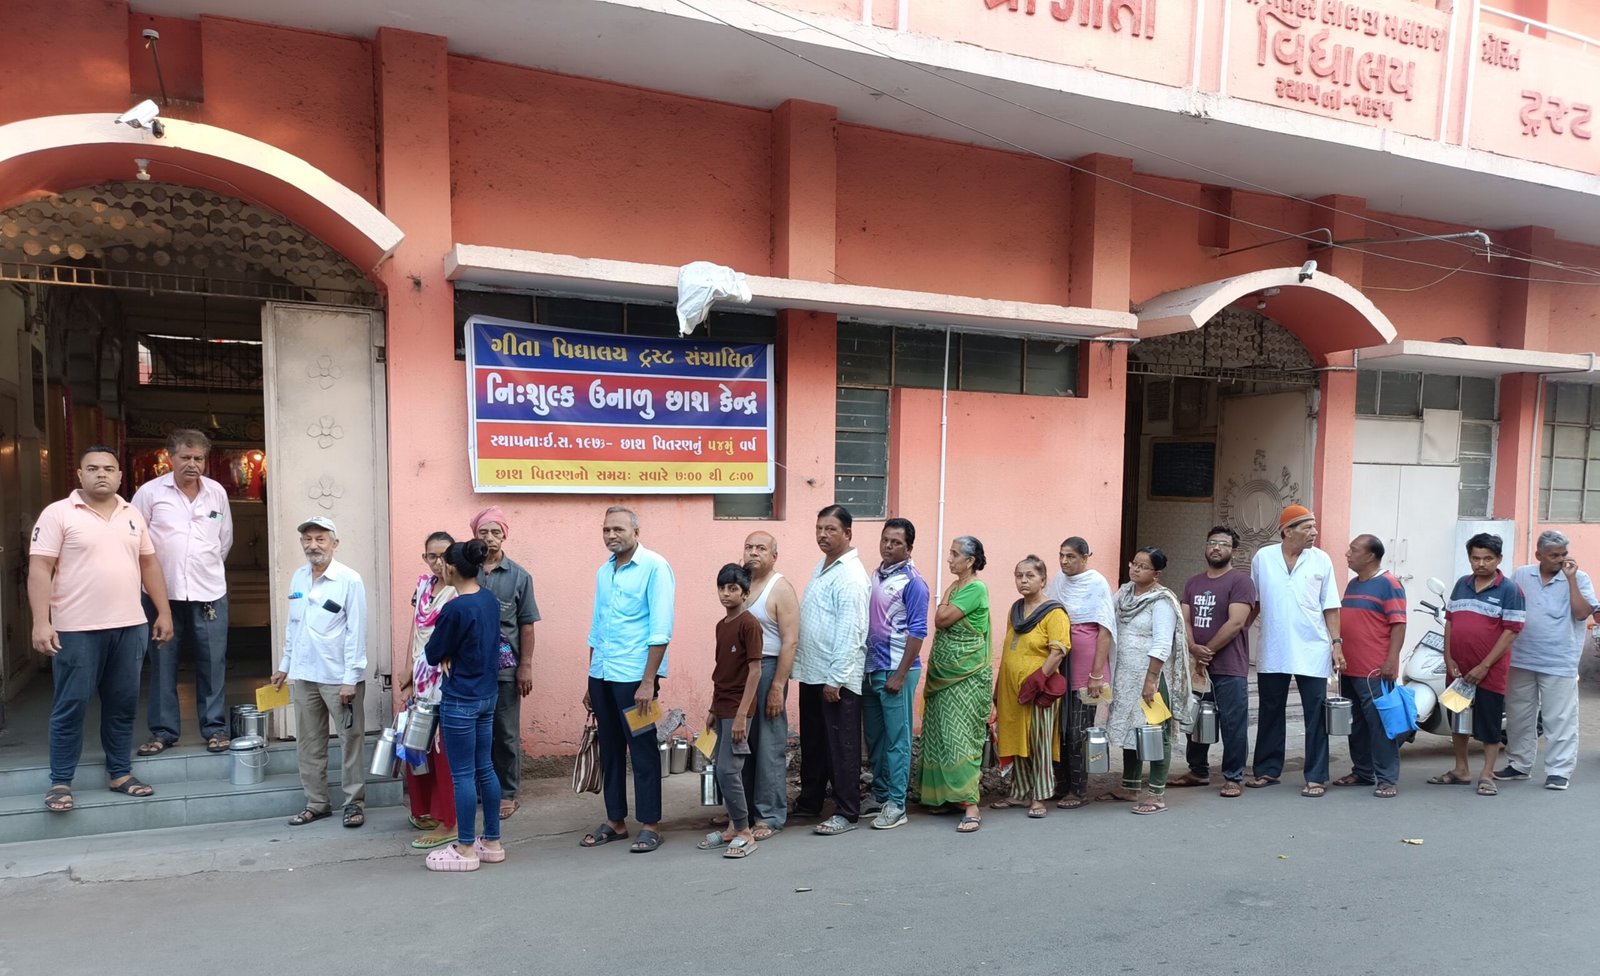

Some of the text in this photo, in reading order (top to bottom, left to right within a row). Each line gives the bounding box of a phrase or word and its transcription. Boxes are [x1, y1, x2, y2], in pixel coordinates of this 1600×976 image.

[1519, 88, 1593, 141] ટ્રસ્ટ
[490, 332, 541, 357] ગીતા
[638, 349, 675, 368] ટ્રસ્ટ
[684, 345, 754, 369] સંચાલિત
[588, 378, 656, 420] ઉનાળુ
[665, 390, 710, 412] છાશ
[718, 382, 758, 415] કેન્દ્ર
[620, 438, 646, 450] છાશ
[652, 434, 703, 455] વિતરણનું
[739, 436, 757, 451] વર્ષ
[495, 468, 523, 480] છાશ
[531, 465, 589, 481] વિતરણનો
[638, 467, 669, 481] સવારે
[708, 467, 722, 481] થી
[33, 527, 40, 542] 3
[1199, 606, 1209, 617] IT
[1194, 616, 1212, 628] OUT
